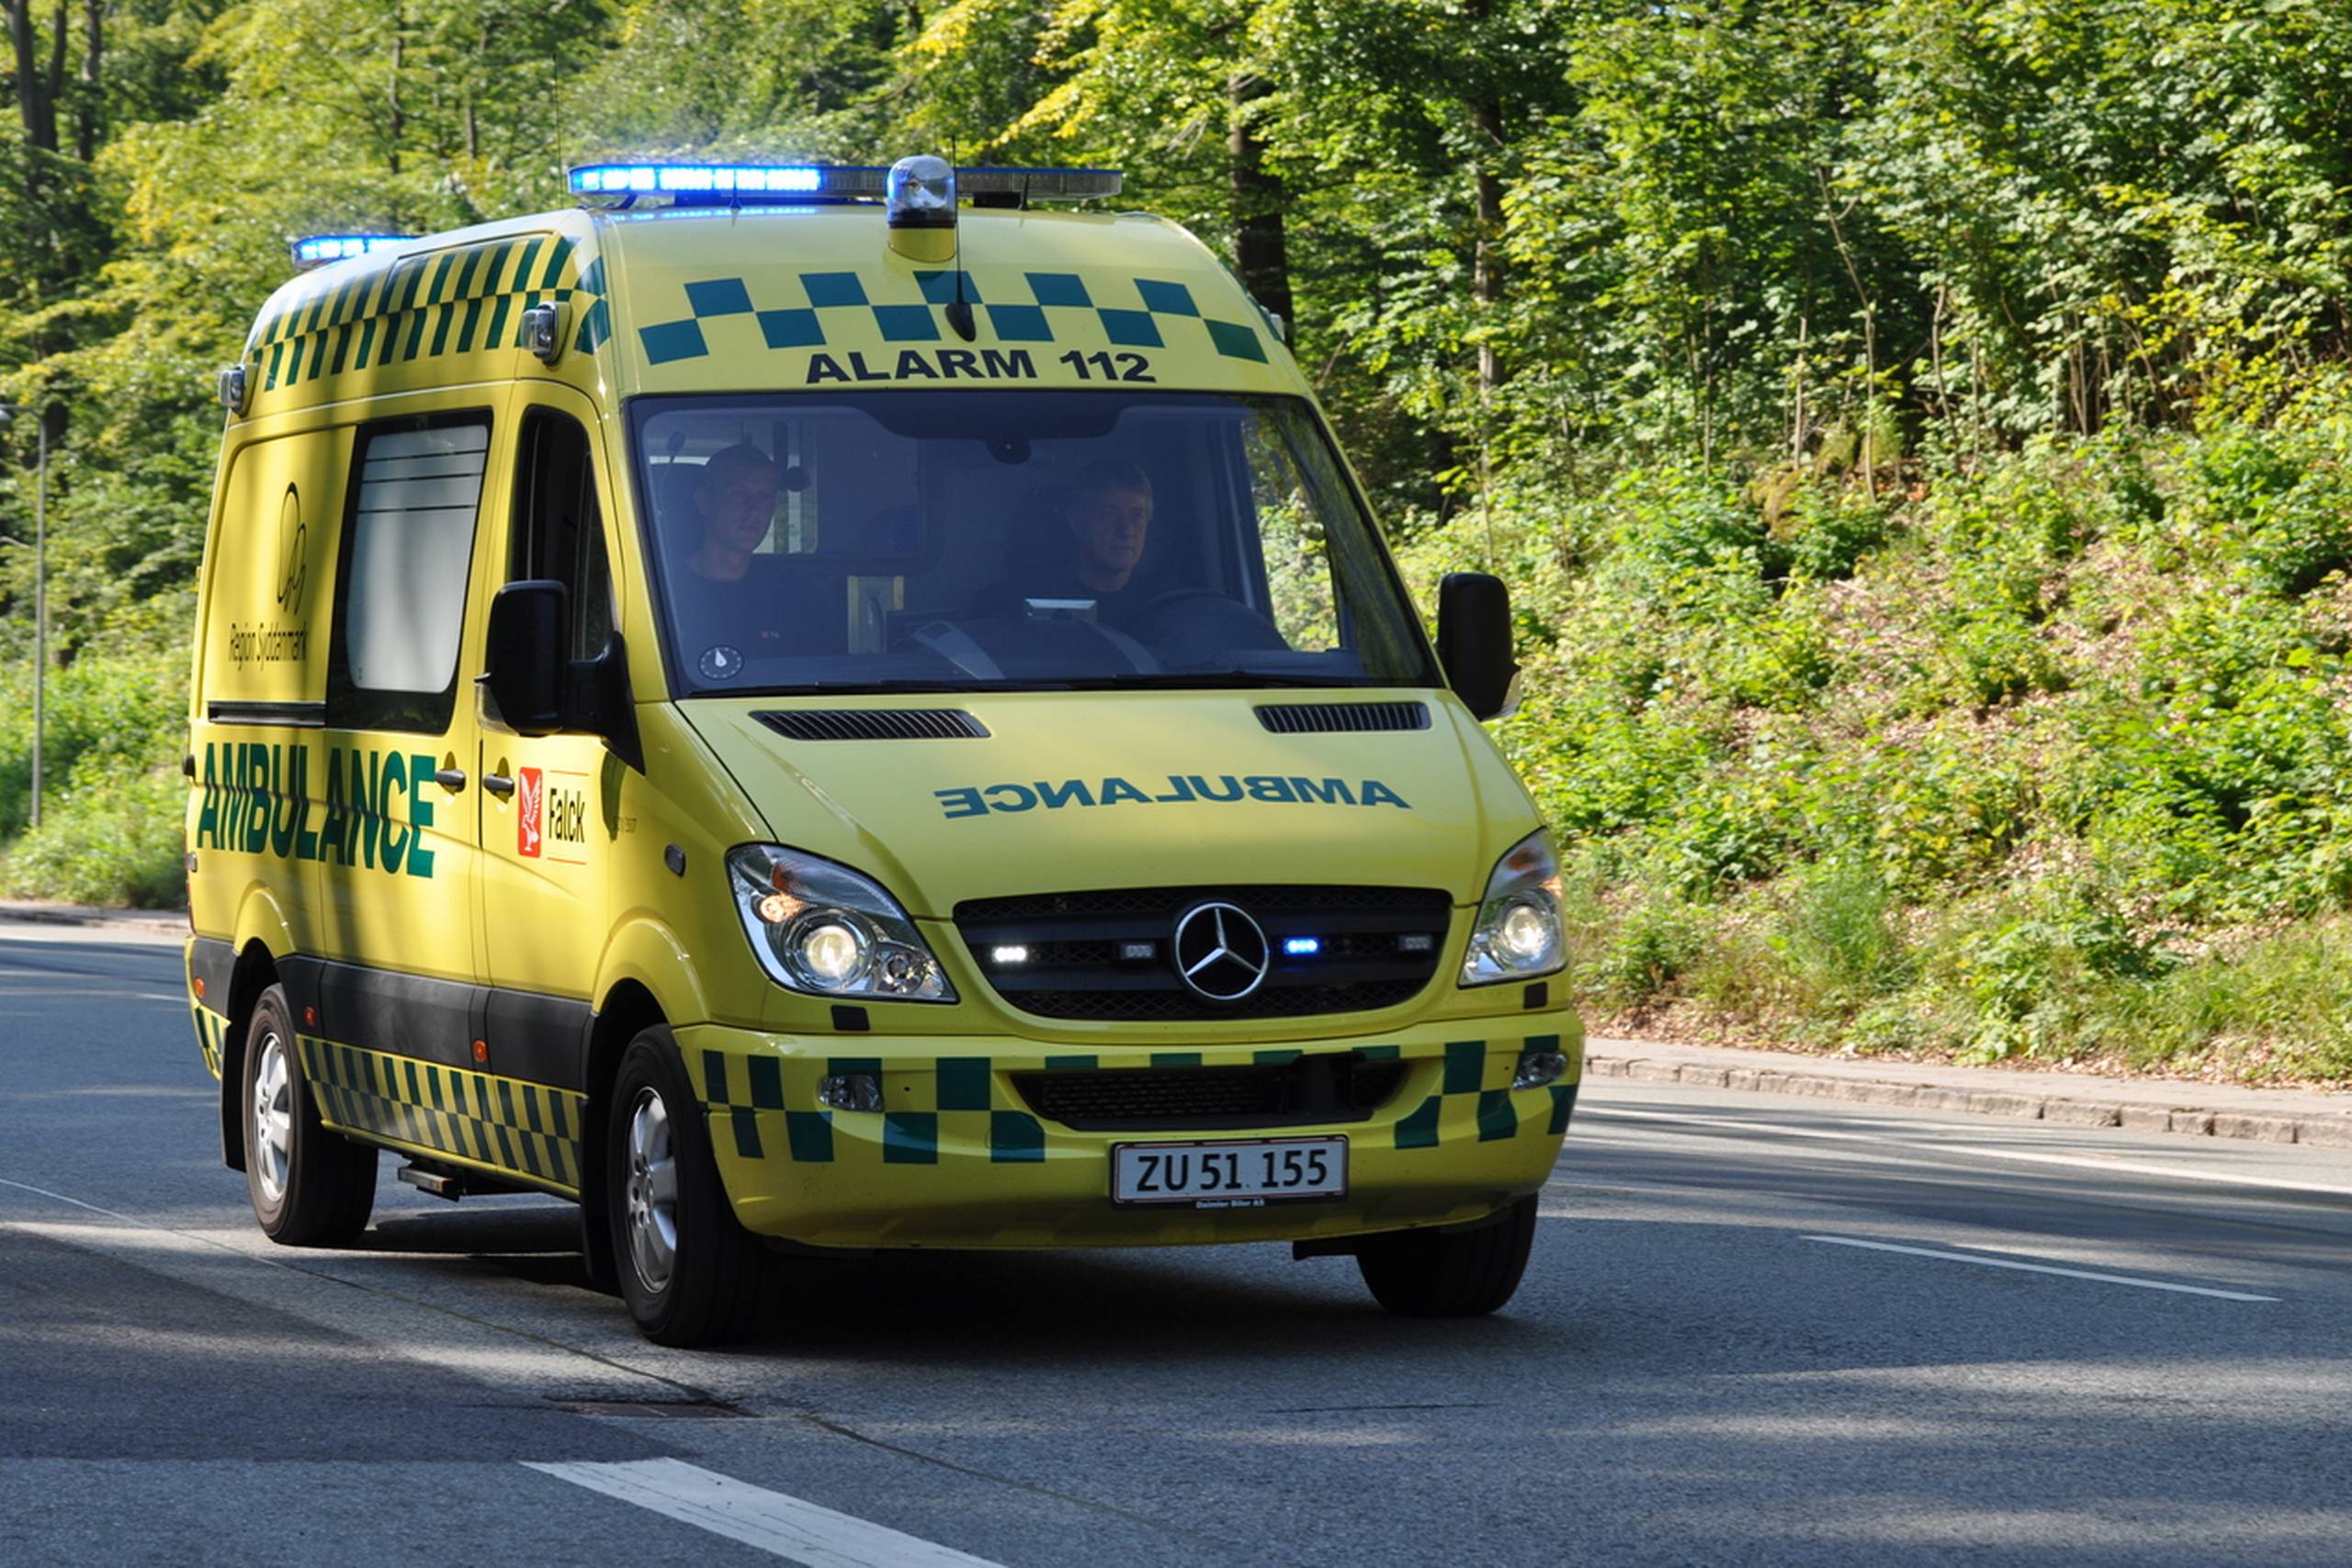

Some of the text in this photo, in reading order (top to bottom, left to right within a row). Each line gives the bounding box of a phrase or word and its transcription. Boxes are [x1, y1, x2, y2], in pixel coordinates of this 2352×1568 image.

[805, 349, 1158, 385] ALARM 112
[197, 741, 436, 879] AMBULANCE
[548, 787, 585, 843] Falck
[1136, 1148, 1328, 1192] ZU 51 155
